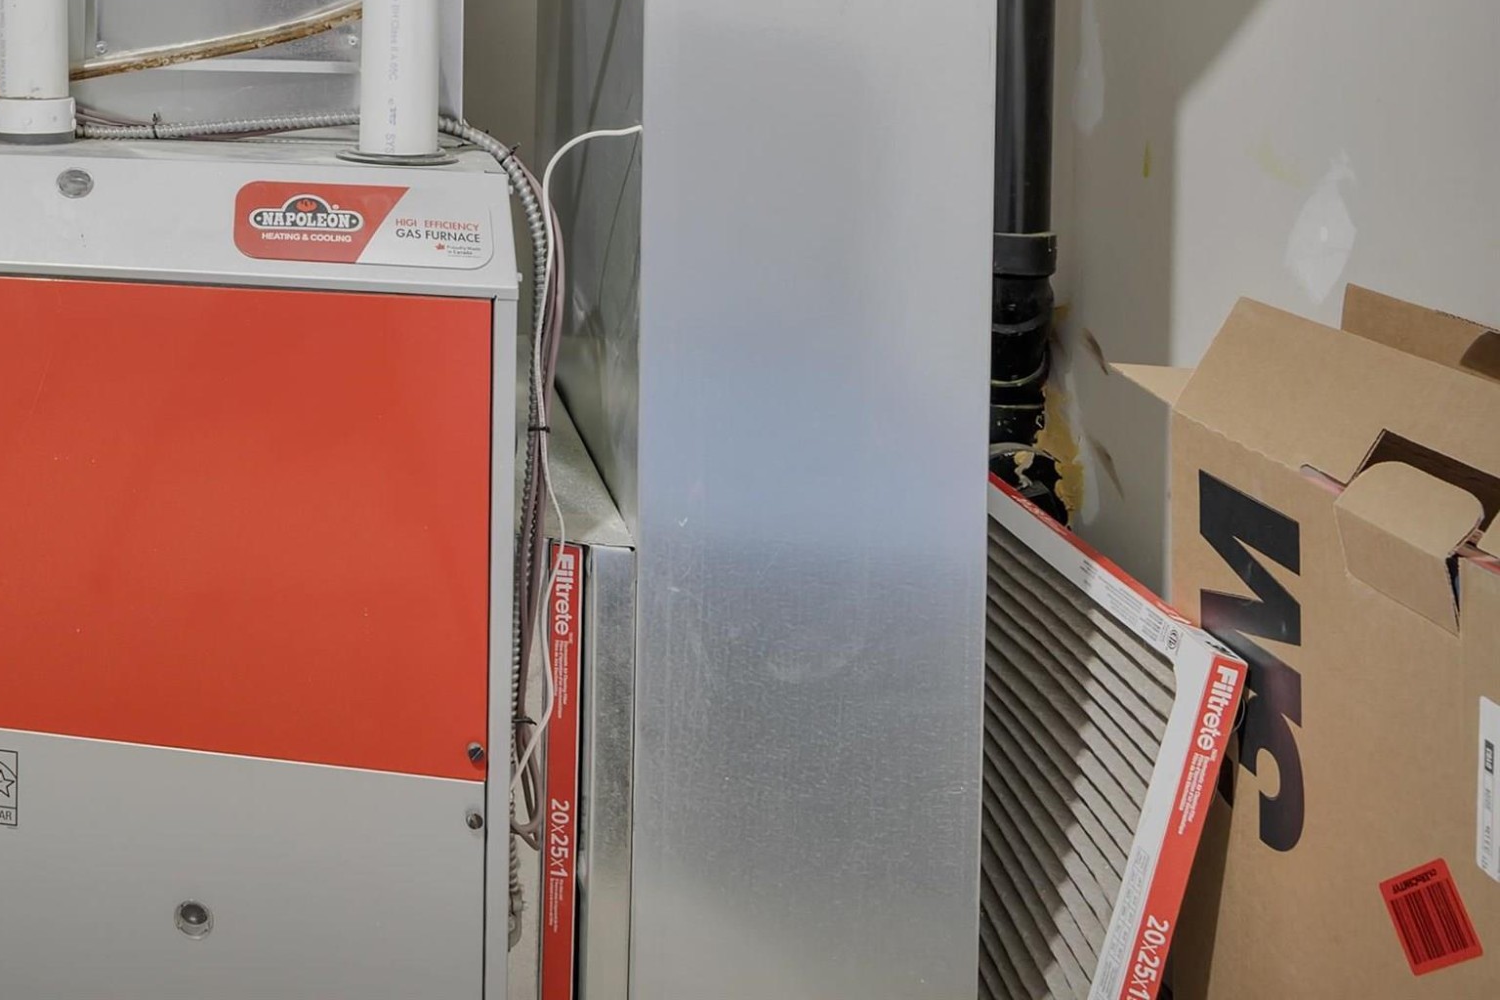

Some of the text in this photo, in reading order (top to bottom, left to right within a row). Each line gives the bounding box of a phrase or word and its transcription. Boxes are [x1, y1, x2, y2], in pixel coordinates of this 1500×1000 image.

[261, 211, 350, 228] NAPOLEON
[261, 232, 352, 243] HEATING & COOLING
[395, 228, 481, 243] GAS FURNACE
[424, 219, 479, 231] EFFICIENCY
[554, 553, 575, 636] Filtrete
[1199, 468, 1305, 852] 3M
[1197, 665, 1239, 751] Filtrete
[550, 798, 570, 878] 20x25x1
